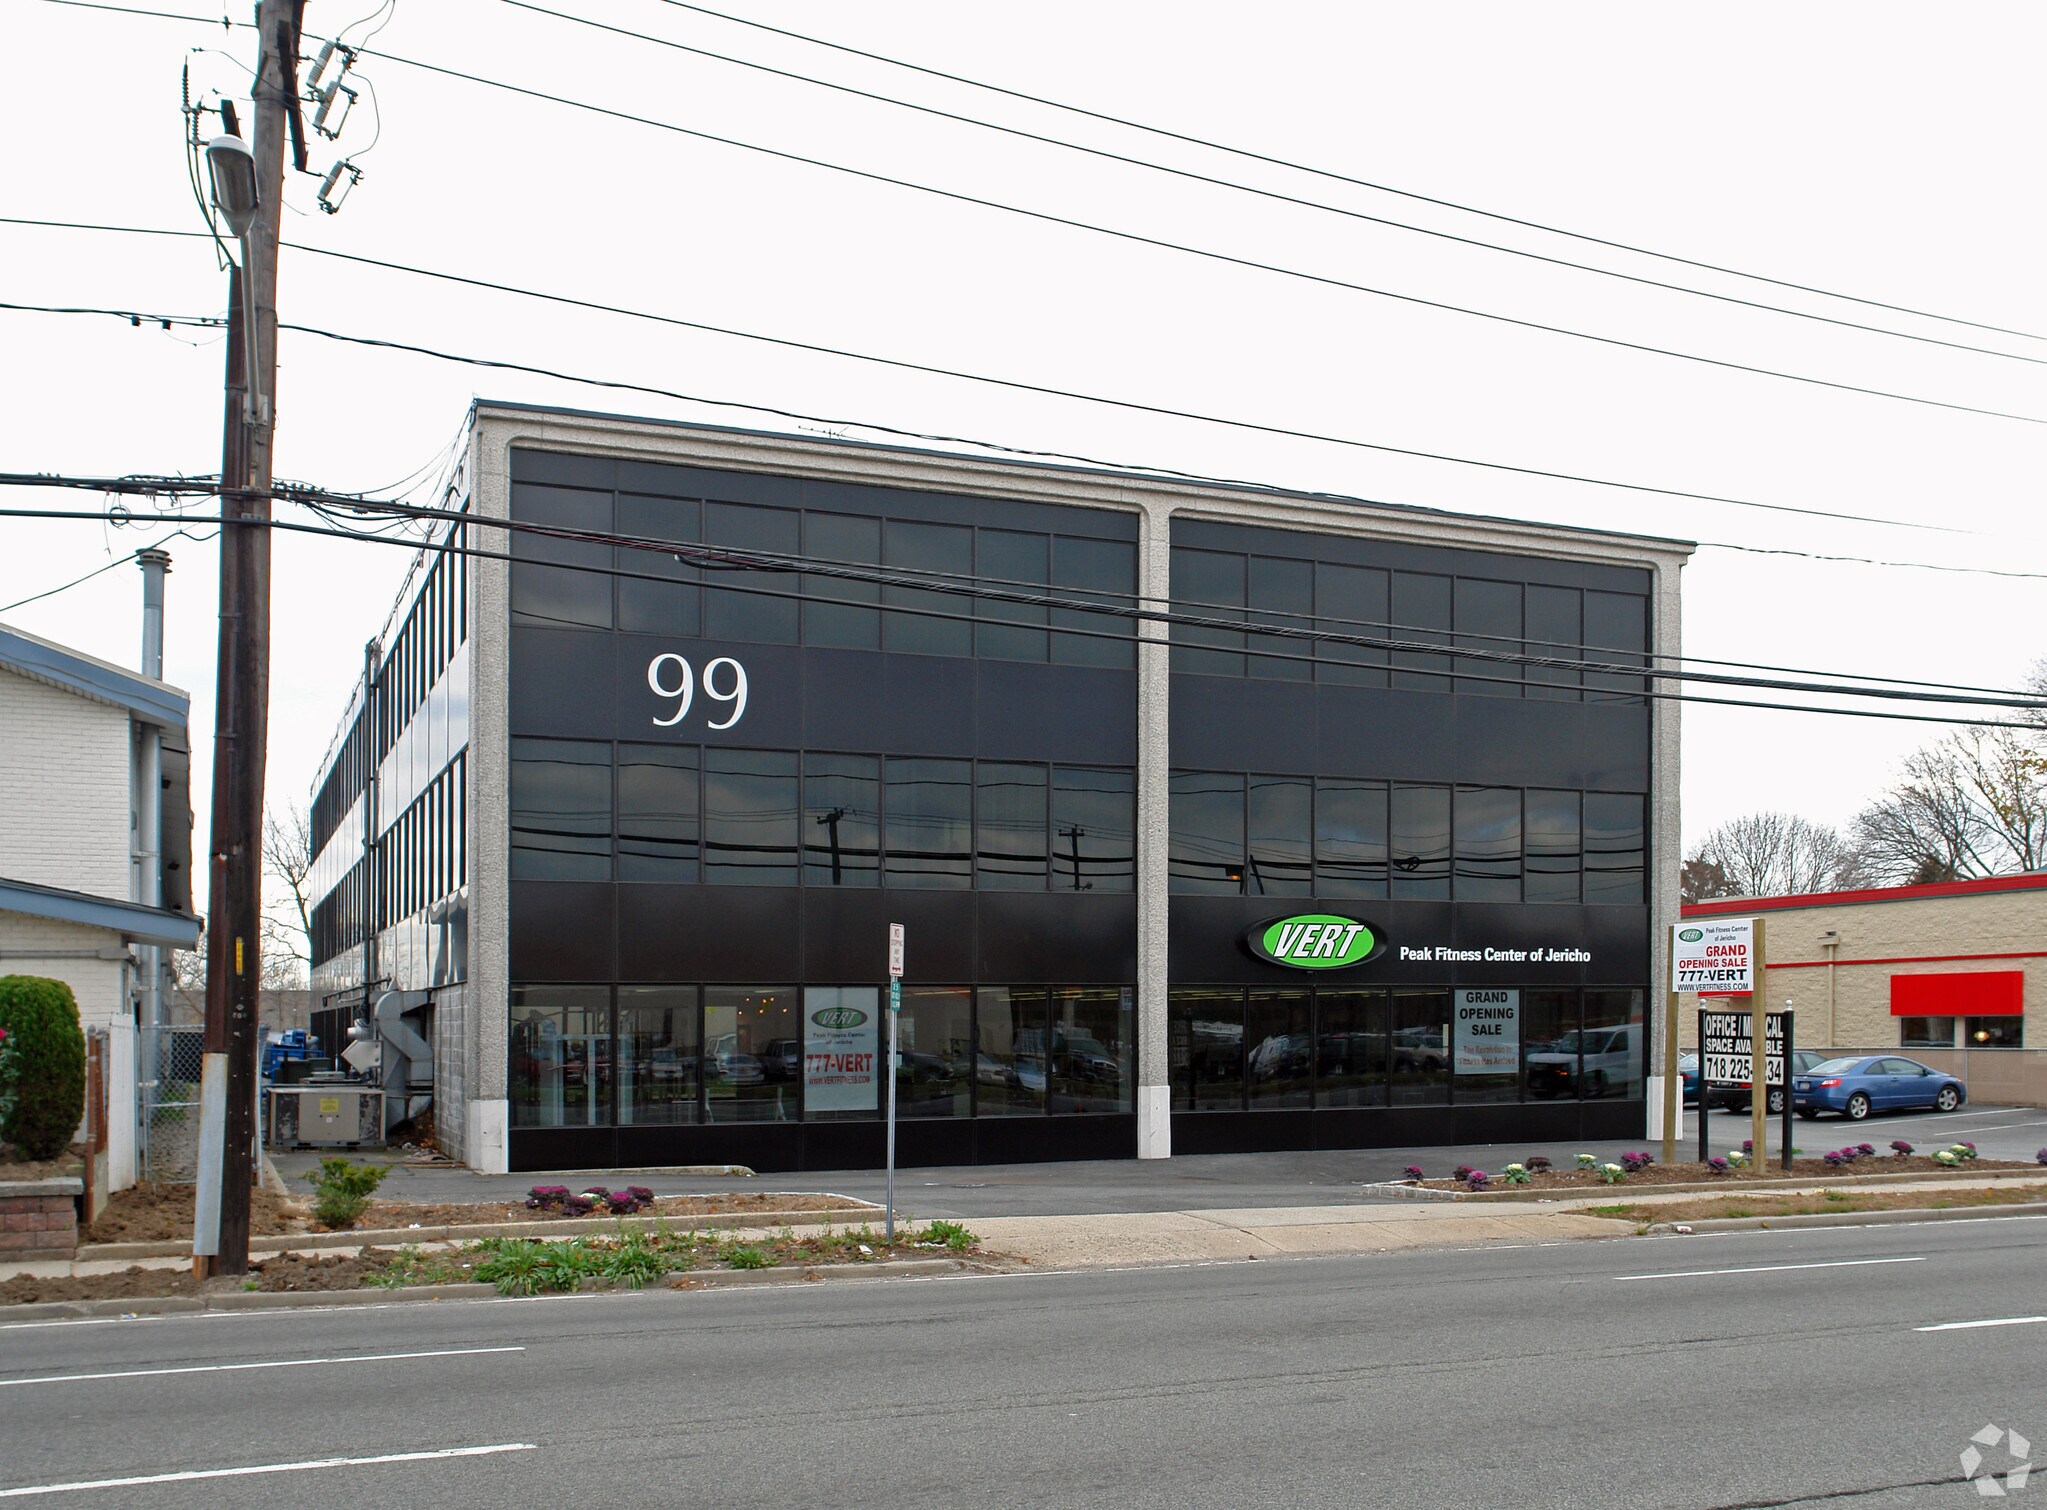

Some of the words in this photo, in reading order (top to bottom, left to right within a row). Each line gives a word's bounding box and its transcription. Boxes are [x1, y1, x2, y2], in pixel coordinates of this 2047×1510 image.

[647, 652, 748, 730] 99
[1731, 925, 1748, 933] Center
[1274, 923, 1365, 958] VERT
[1400, 946, 1432, 961] Peak
[1435, 946, 1482, 961] Fitness
[1484, 947, 1527, 962] Center
[1530, 947, 1544, 962] of
[1545, 948, 1591, 963] Jericho
[1706, 944, 1747, 957] GRAND
[1679, 959, 1719, 969] OPENING
[1721, 957, 1748, 968] SALE
[1679, 969, 1747, 982] 777-VERT
[1466, 991, 1508, 1003] GRAND
[822, 1012, 857, 1024] VERT
[1460, 1008, 1514, 1019] OPENING
[1472, 1024, 1502, 1035] SALE
[1705, 1015, 1737, 1037] OFFICE
[1743, 1015, 1784, 1038] MCAL
[1706, 1038, 1733, 1053] SPACE
[1735, 1039, 1783, 1055] AVABLE
[806, 1053, 873, 1073] 777-VERT
[1706, 1057, 1726, 1078] 718
